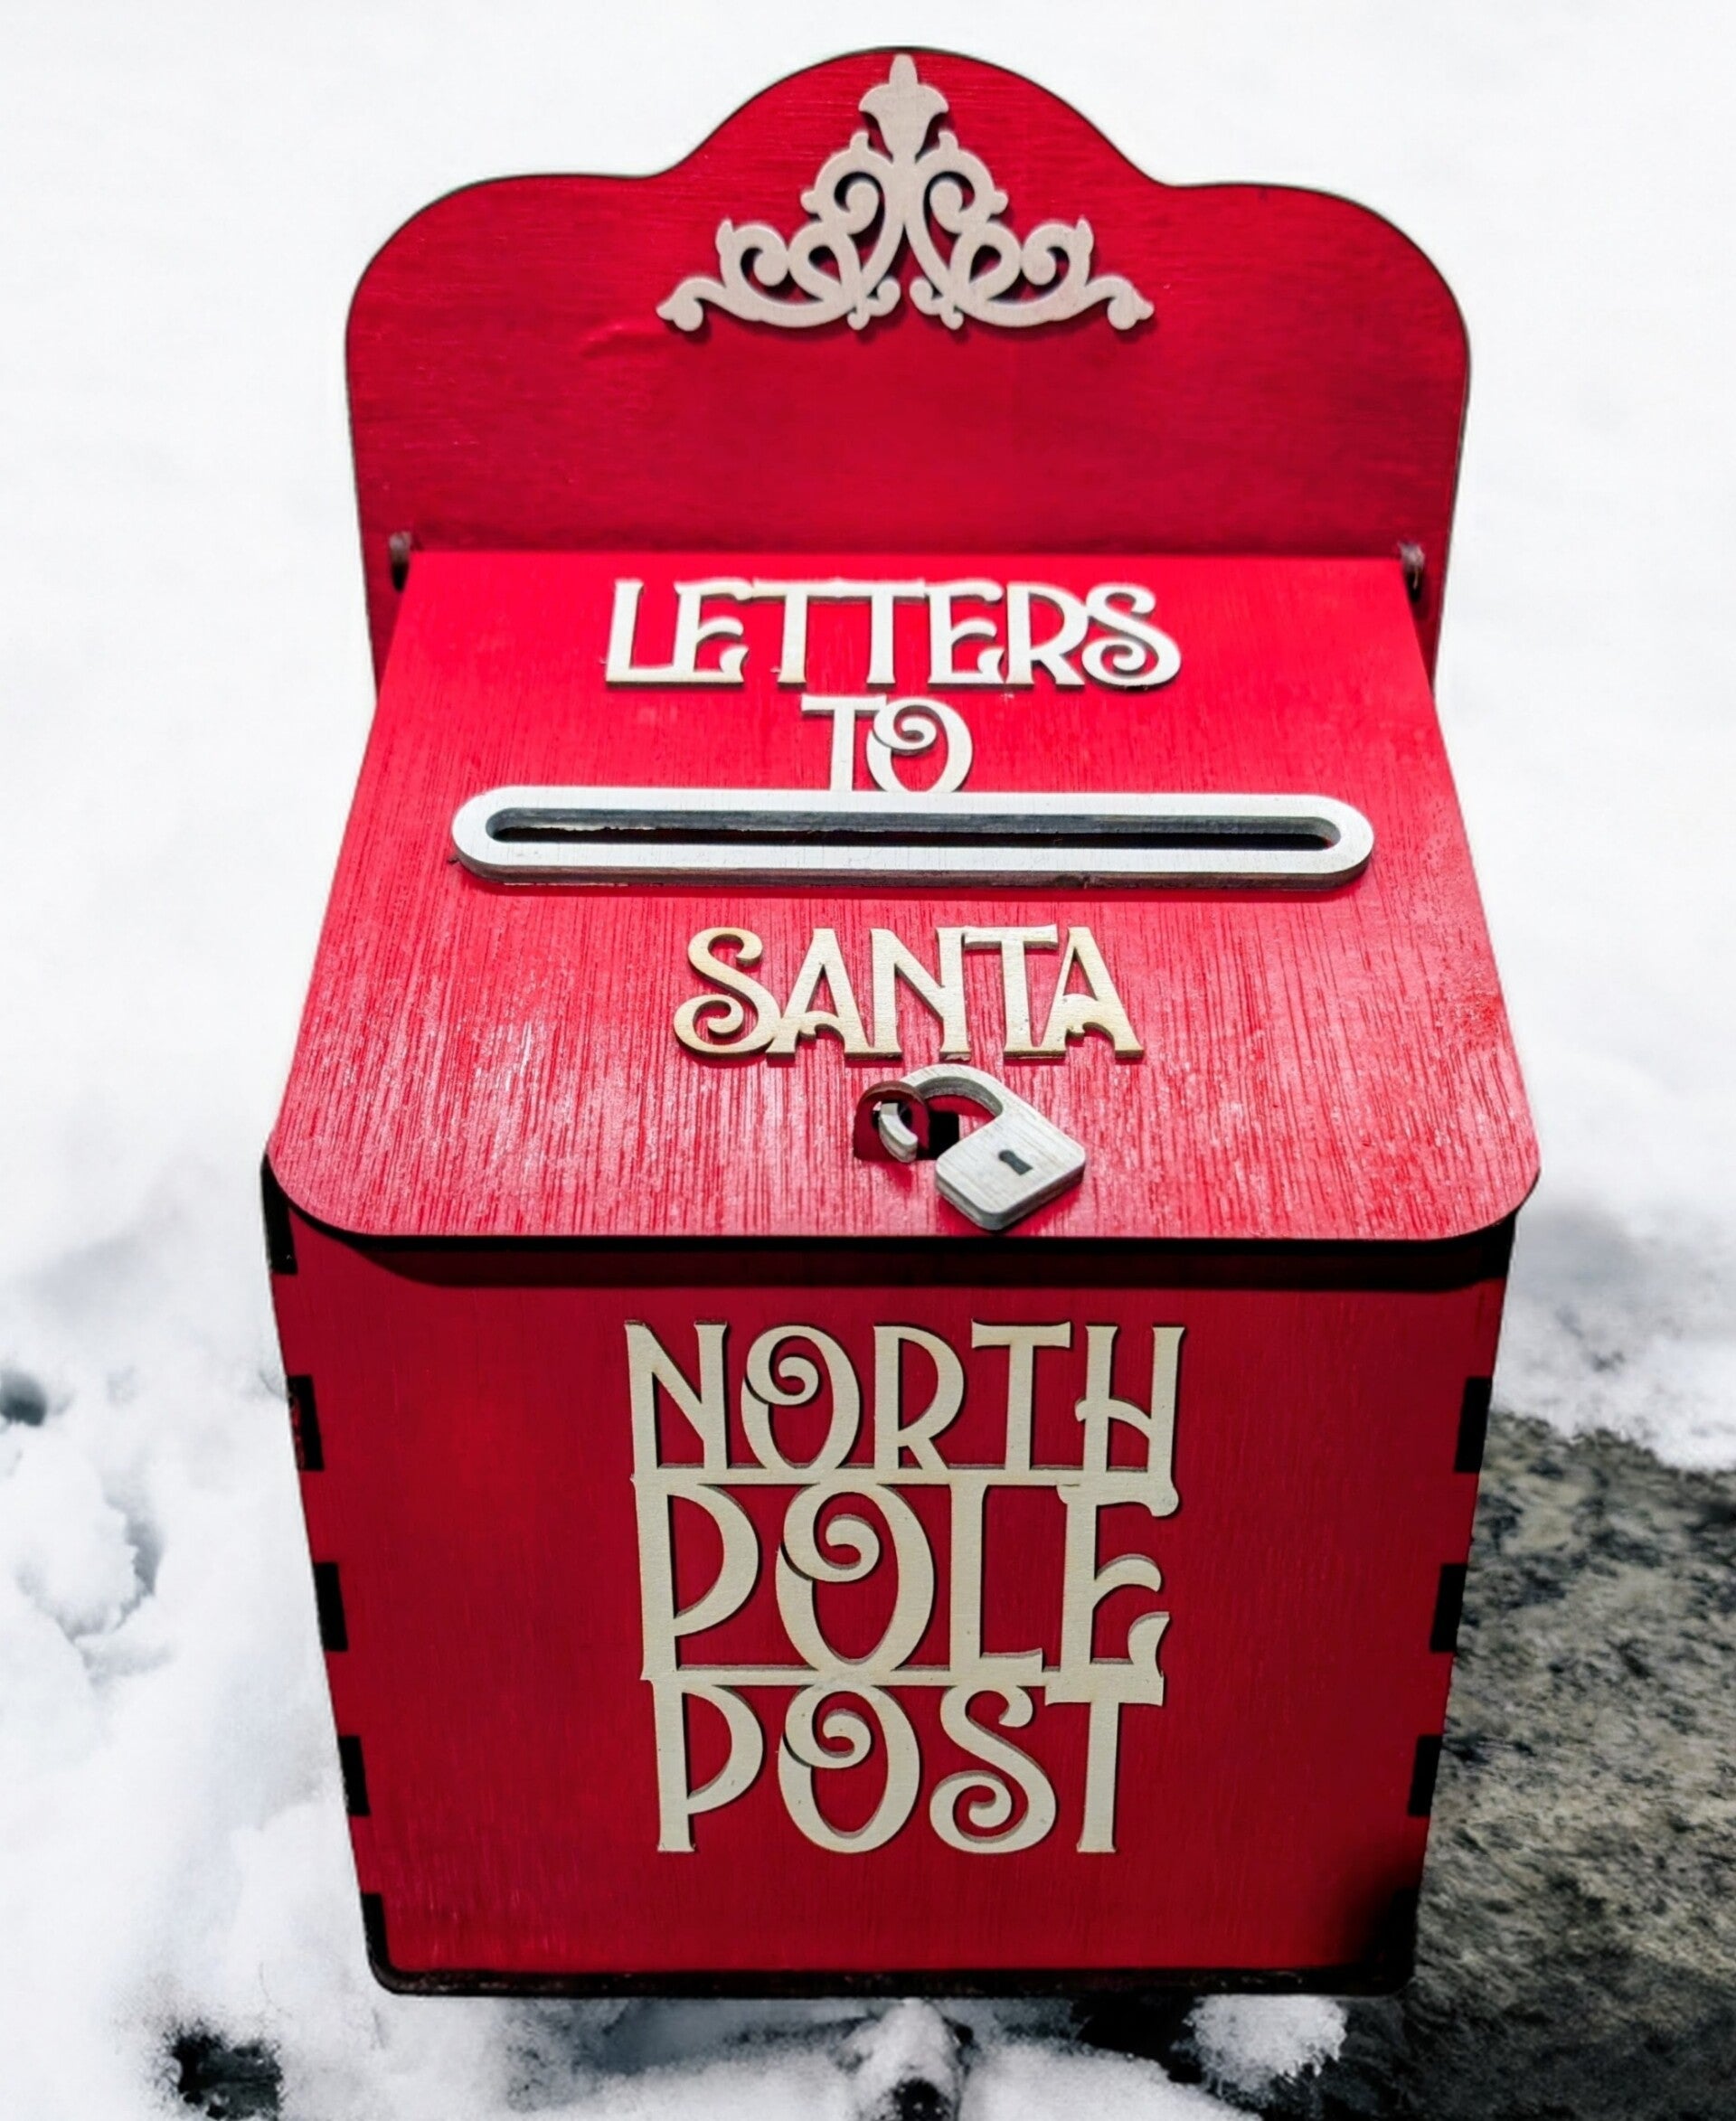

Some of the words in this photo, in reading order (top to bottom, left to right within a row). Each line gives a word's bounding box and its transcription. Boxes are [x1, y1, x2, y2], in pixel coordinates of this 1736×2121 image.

[605, 579, 1182, 689] LETTERS
[801, 693, 974, 793] TO
[674, 926, 1144, 1060] SANTA
[626, 1321, 1185, 1485] NORTH
[633, 1484, 1179, 1686] POLE
[647, 1673, 1165, 1853] POST
